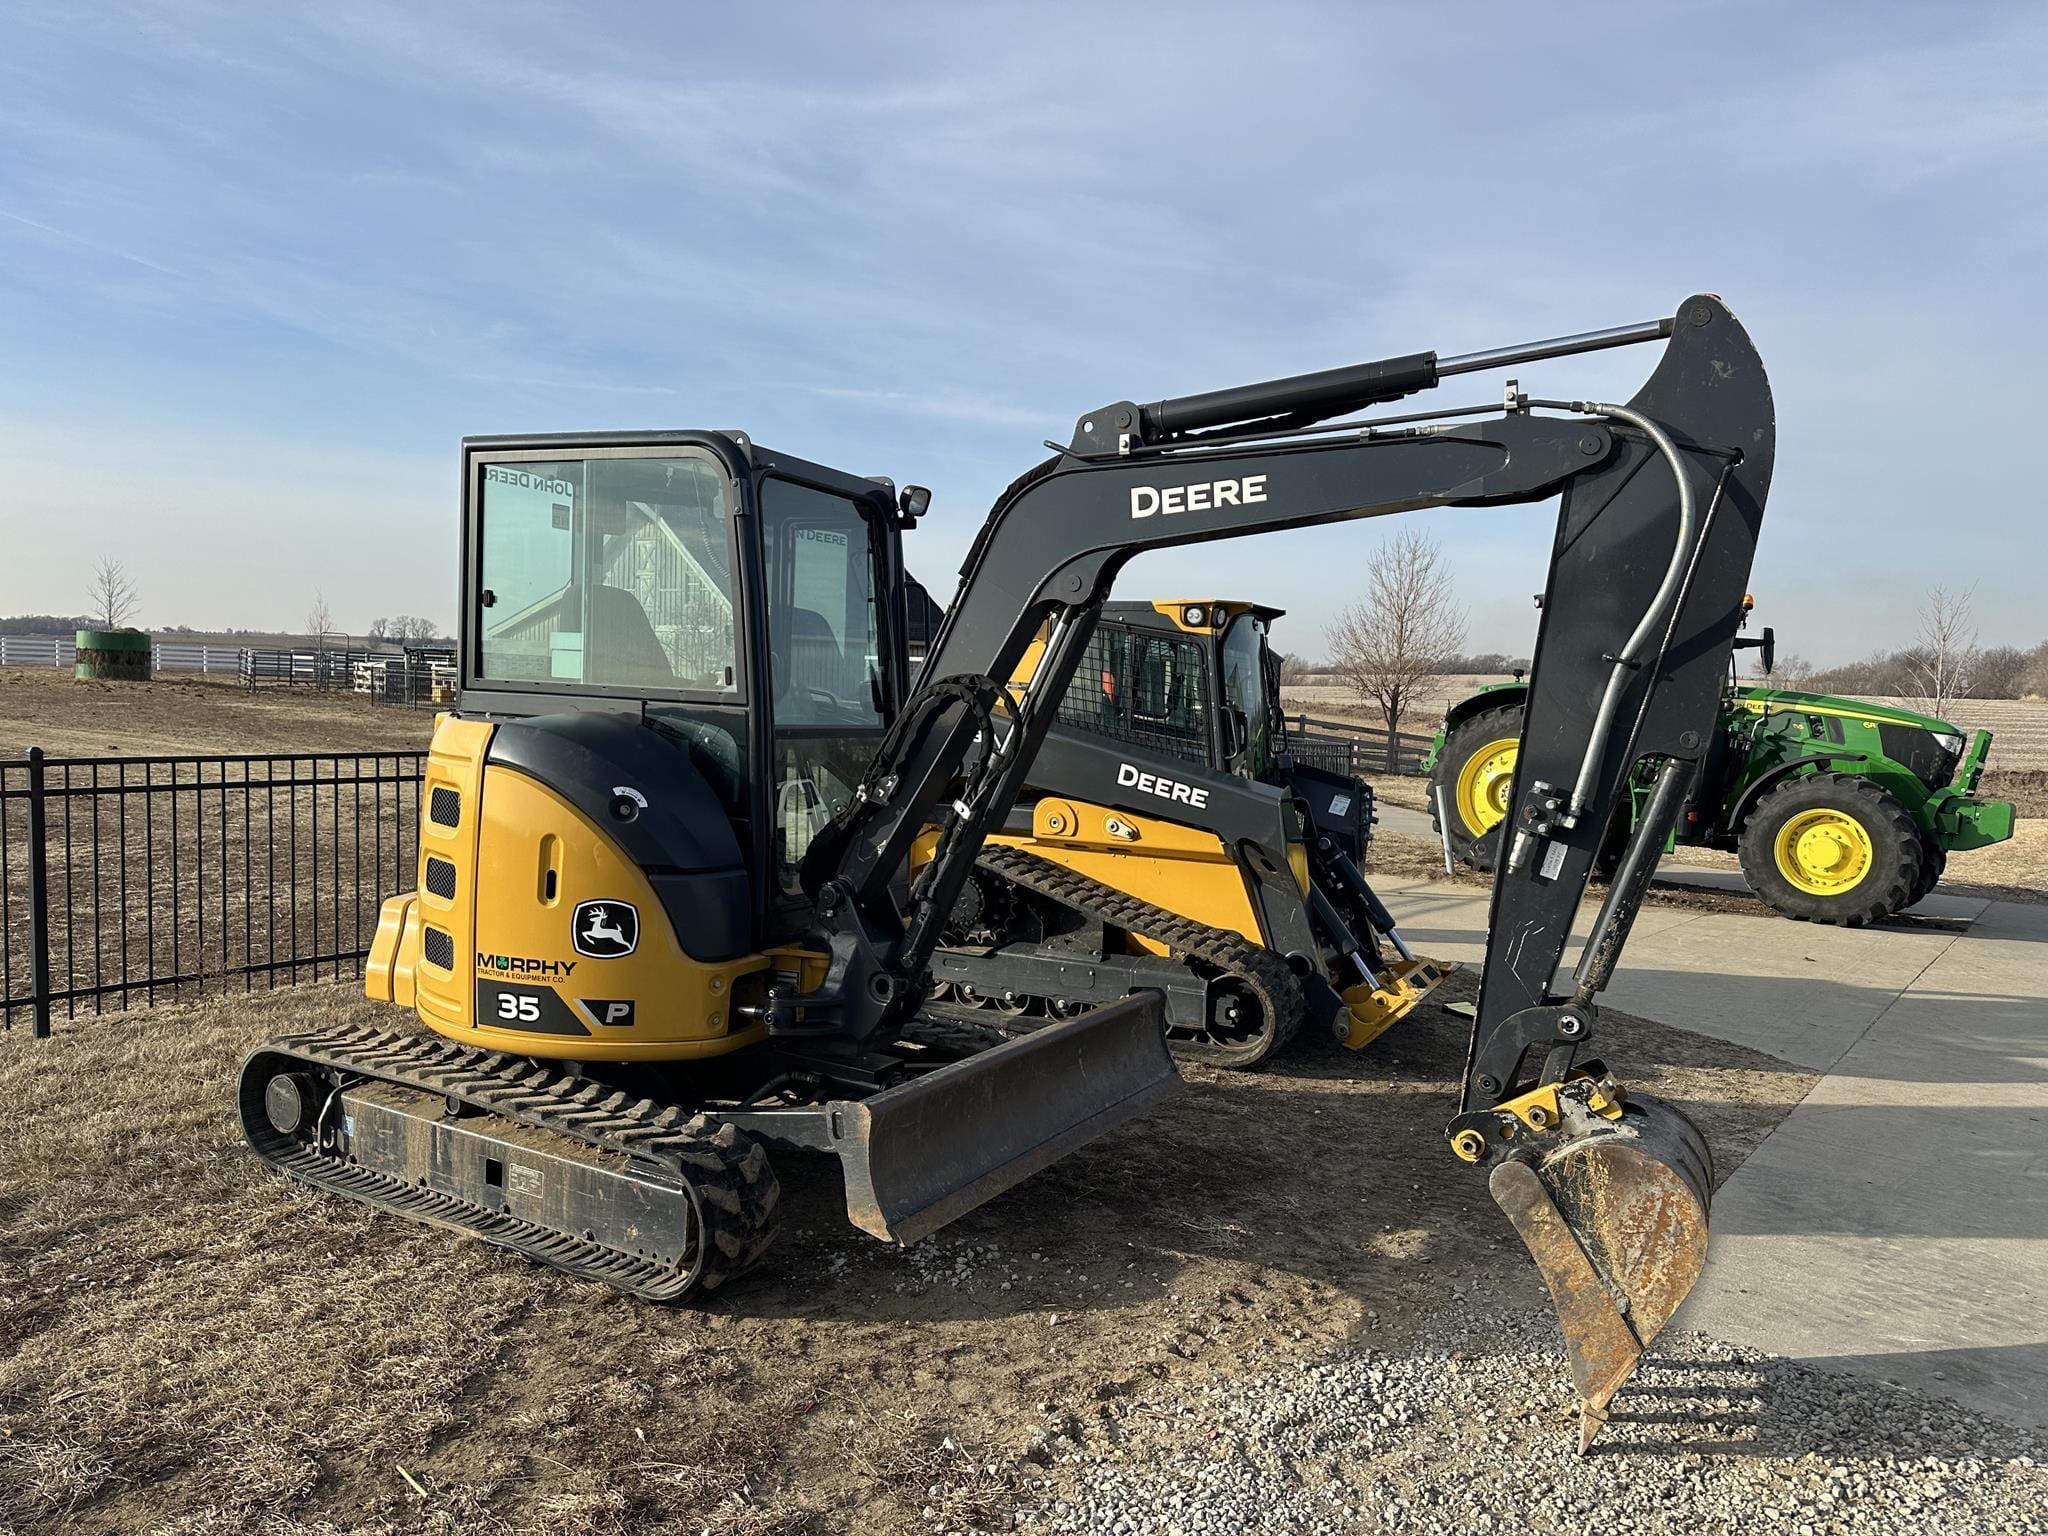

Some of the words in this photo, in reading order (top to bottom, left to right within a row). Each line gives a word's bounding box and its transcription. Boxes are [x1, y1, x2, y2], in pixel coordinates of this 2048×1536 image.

[1130, 474, 1267, 519] DEERE
[806, 529, 847, 546] DEERE
[1117, 762, 1210, 810] DEERE
[477, 952, 578, 977] MURPHY
[477, 967, 505, 978] TRACTOR
[511, 972, 550, 983] EQUIPMENT
[552, 976, 566, 984] CO.
[497, 992, 541, 1023] 35
[605, 1003, 630, 1023] P
